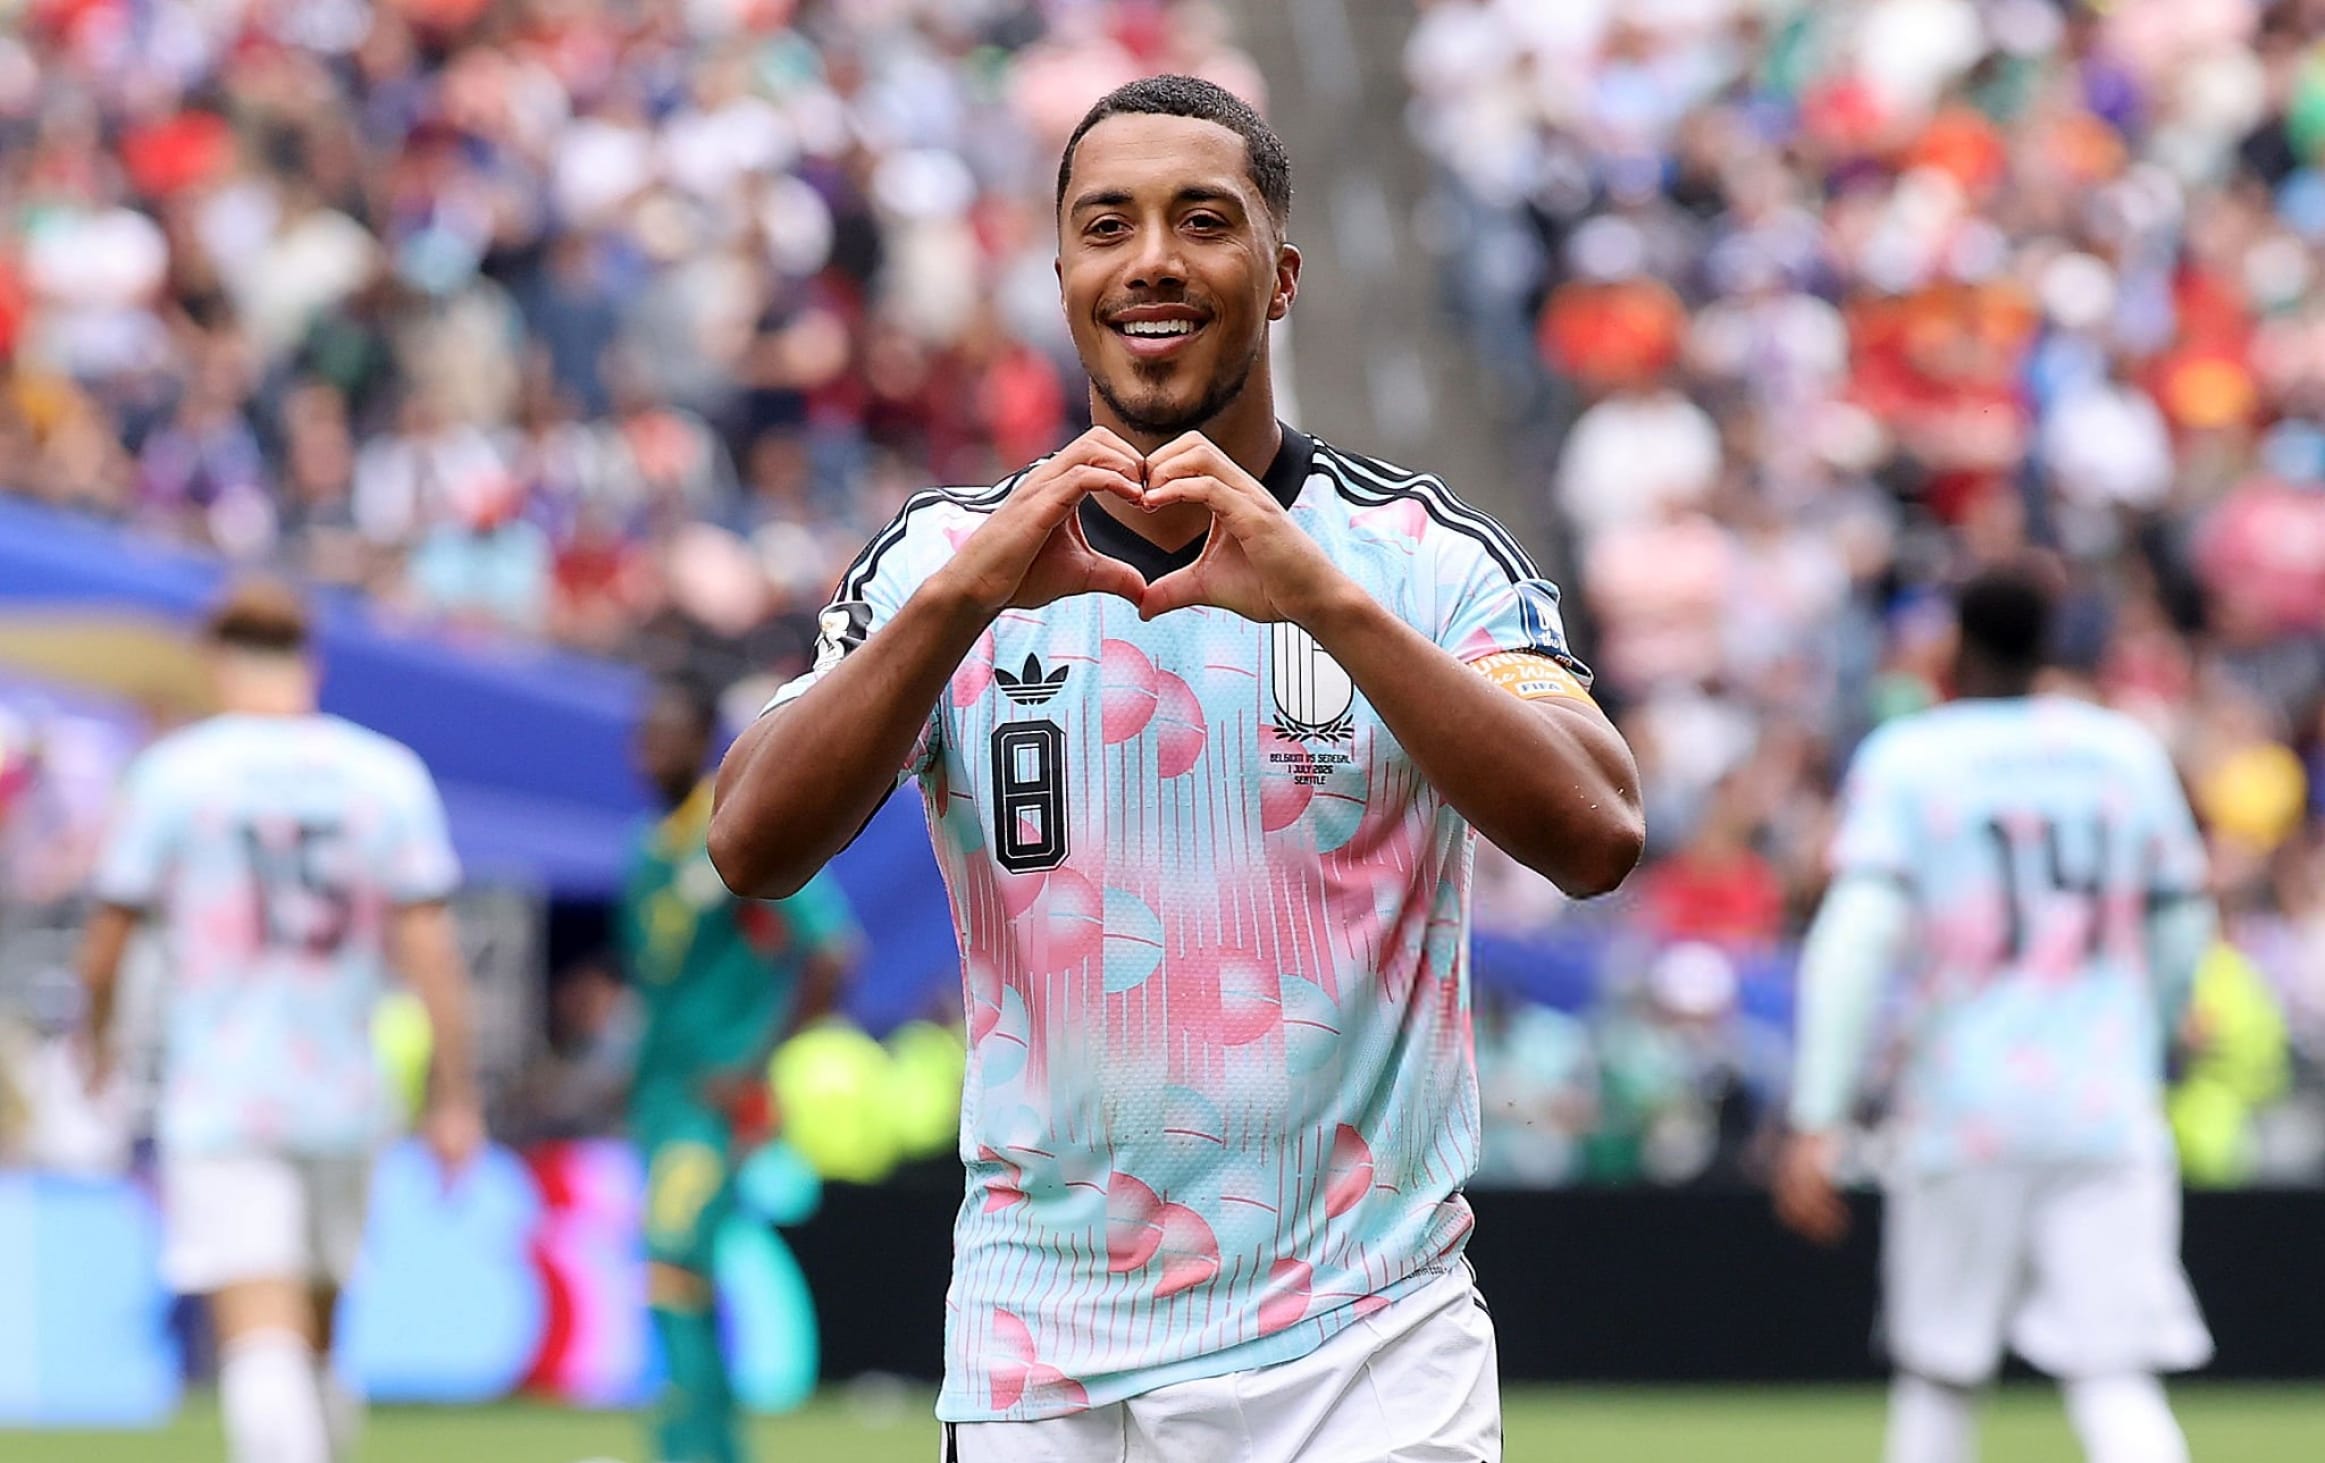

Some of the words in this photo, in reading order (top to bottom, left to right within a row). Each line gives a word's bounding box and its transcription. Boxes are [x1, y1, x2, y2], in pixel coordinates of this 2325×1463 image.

[1520, 682, 1561, 692] FIFA
[1269, 753, 1304, 763] BELGIUM
[1305, 753, 1316, 763] VS
[1317, 753, 1352, 764] SENEGAL
[1288, 764, 1292, 774] 1
[1293, 764, 1312, 774] JULY
[1312, 764, 1334, 774] 2026
[1294, 775, 1327, 785] SEATTLE
[991, 719, 1070, 875] 8
[239, 817, 352, 958] 15
[1985, 812, 2108, 962] 14
